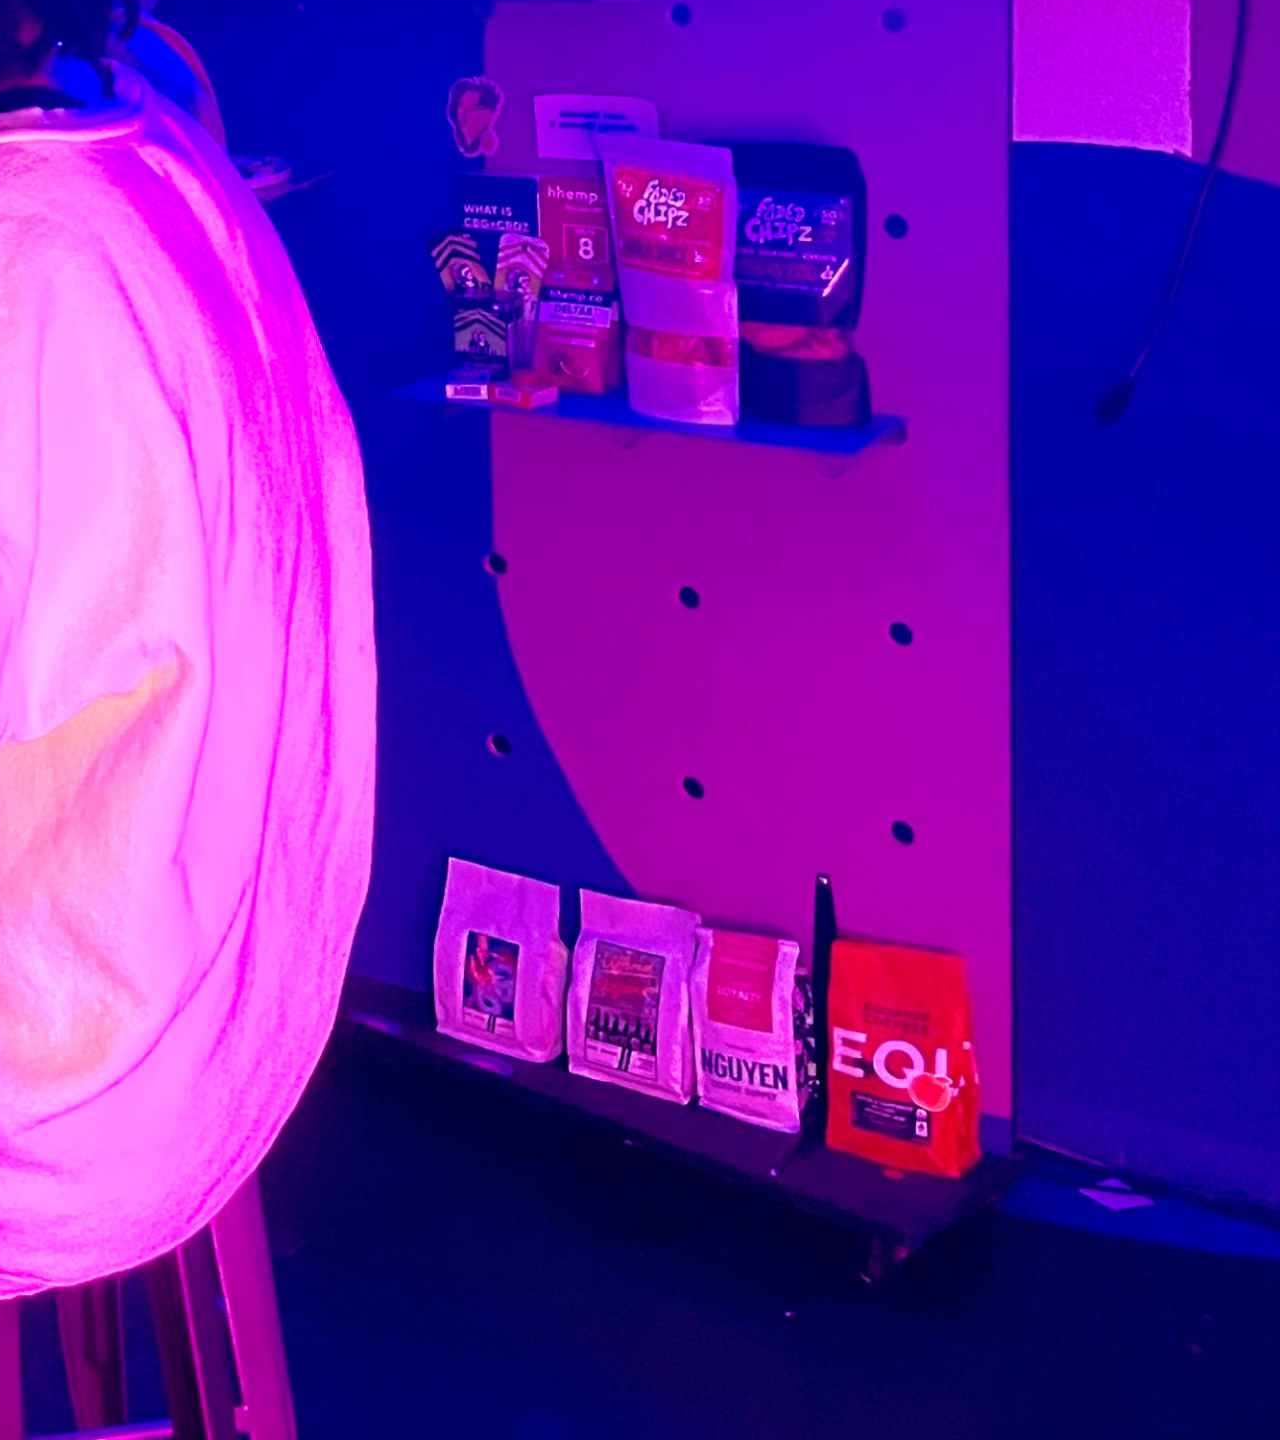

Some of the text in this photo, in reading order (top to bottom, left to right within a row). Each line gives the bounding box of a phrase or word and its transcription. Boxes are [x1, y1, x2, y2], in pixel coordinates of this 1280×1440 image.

[643, 179, 686, 207] FADED
[464, 204, 513, 217] WHAT IS
[633, 199, 690, 228] CHIPZ
[757, 198, 805, 223] FADED
[745, 217, 813, 245] CHIPZ
[578, 237, 595, 259] 8
[701, 1048, 789, 1090] NGUYEN
